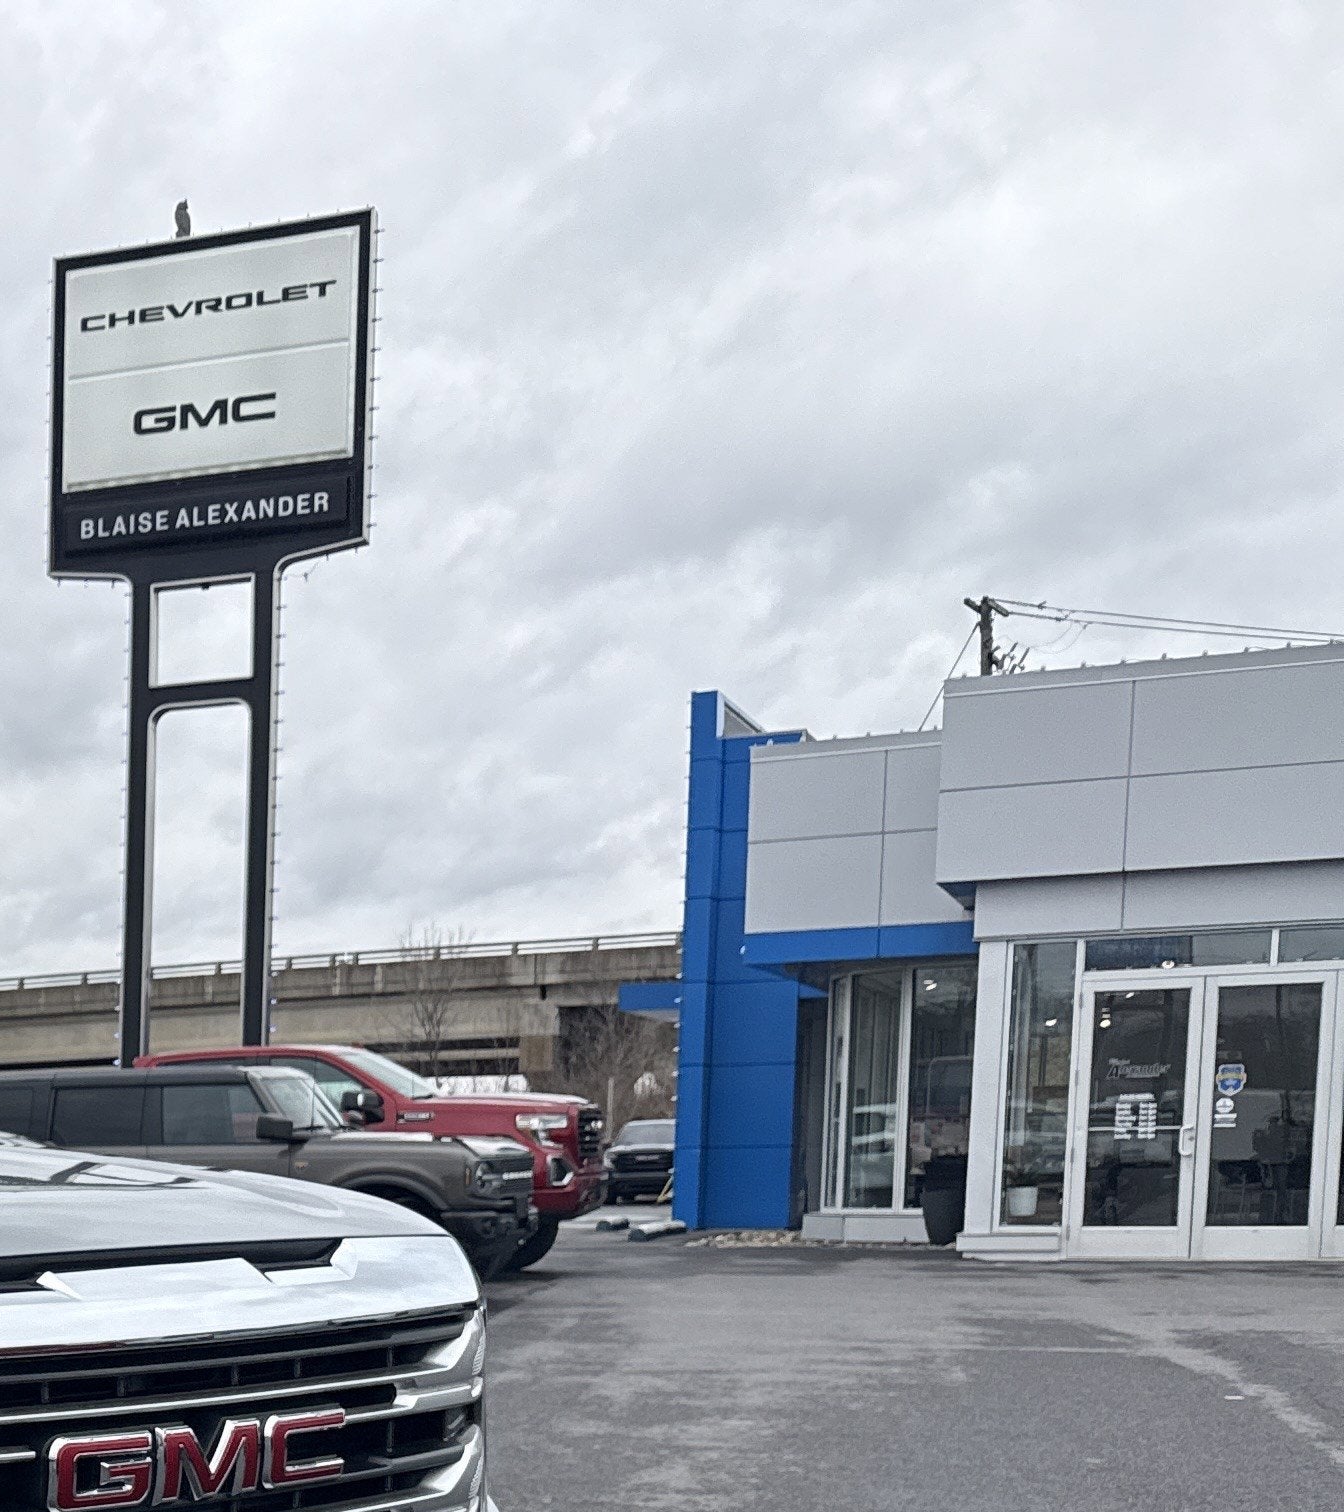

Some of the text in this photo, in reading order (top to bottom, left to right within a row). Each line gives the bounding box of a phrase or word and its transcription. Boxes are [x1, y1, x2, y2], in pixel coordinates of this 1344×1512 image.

[80, 280, 337, 332] CHEVROLET
[133, 392, 277, 435] GMC
[80, 491, 330, 540] BLAISE ALEXANDER
